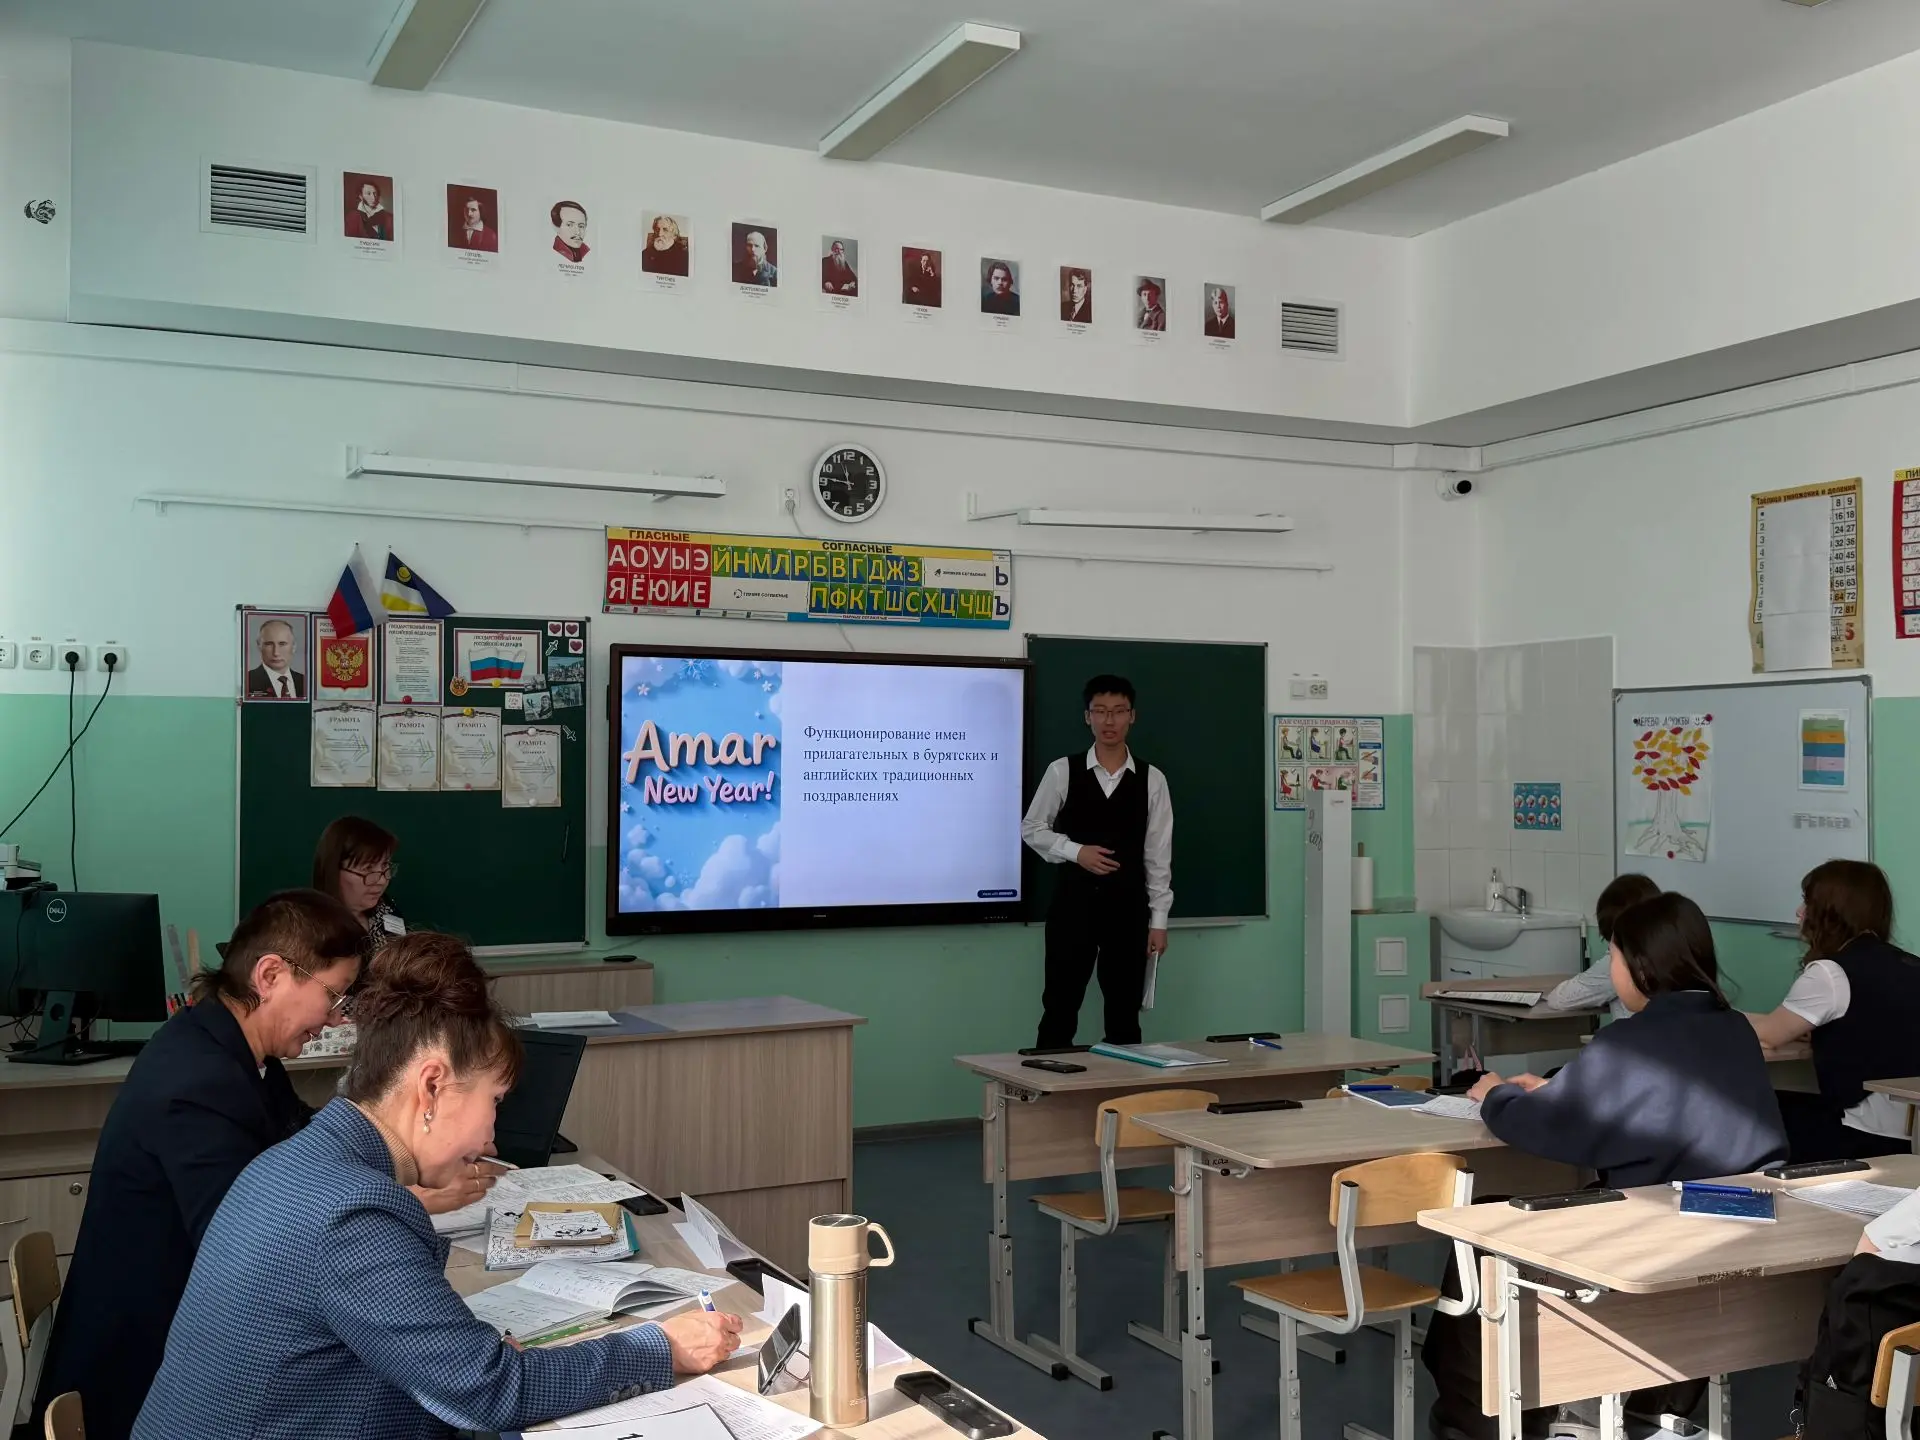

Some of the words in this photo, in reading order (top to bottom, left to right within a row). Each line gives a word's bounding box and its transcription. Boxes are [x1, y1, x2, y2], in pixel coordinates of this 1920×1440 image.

[832, 454, 841, 464] 11
[843, 451, 855, 461] 12
[860, 455, 864, 465] 1
[822, 463, 833, 473] 10
[865, 466, 874, 476] 2
[1906, 468, 1920, 480] ПИ
[820, 477, 828, 486] 9
[869, 480, 877, 489] 3
[822, 490, 831, 501] 8
[865, 493, 874, 503] 4
[1757, 495, 1781, 506] Таблица
[1783, 489, 1819, 503] умножения
[1827, 484, 1856, 495] деления
[831, 501, 840, 511] 7
[856, 502, 865, 512] 5
[1836, 498, 1841, 507] 8
[1847, 496, 1853, 506] 9
[843, 505, 852, 515] 6
[629, 529, 690, 542] ГЛАСНЫЕ
[822, 541, 893, 554] СОГЛАСНЫЕ
[804, 725, 931, 742] Функционирование
[935, 729, 967, 741] имен
[623, 719, 777, 784] Amar
[803, 749, 908, 762] прилагательных
[913, 751, 920, 760] в
[923, 748, 987, 763] бурятских
[991, 752, 999, 761] и
[803, 768, 878, 781] английских
[883, 770, 974, 784] традиционных
[643, 775, 699, 805] New
[703, 770, 775, 804] Year!
[803, 790, 900, 804] поздравлениях
